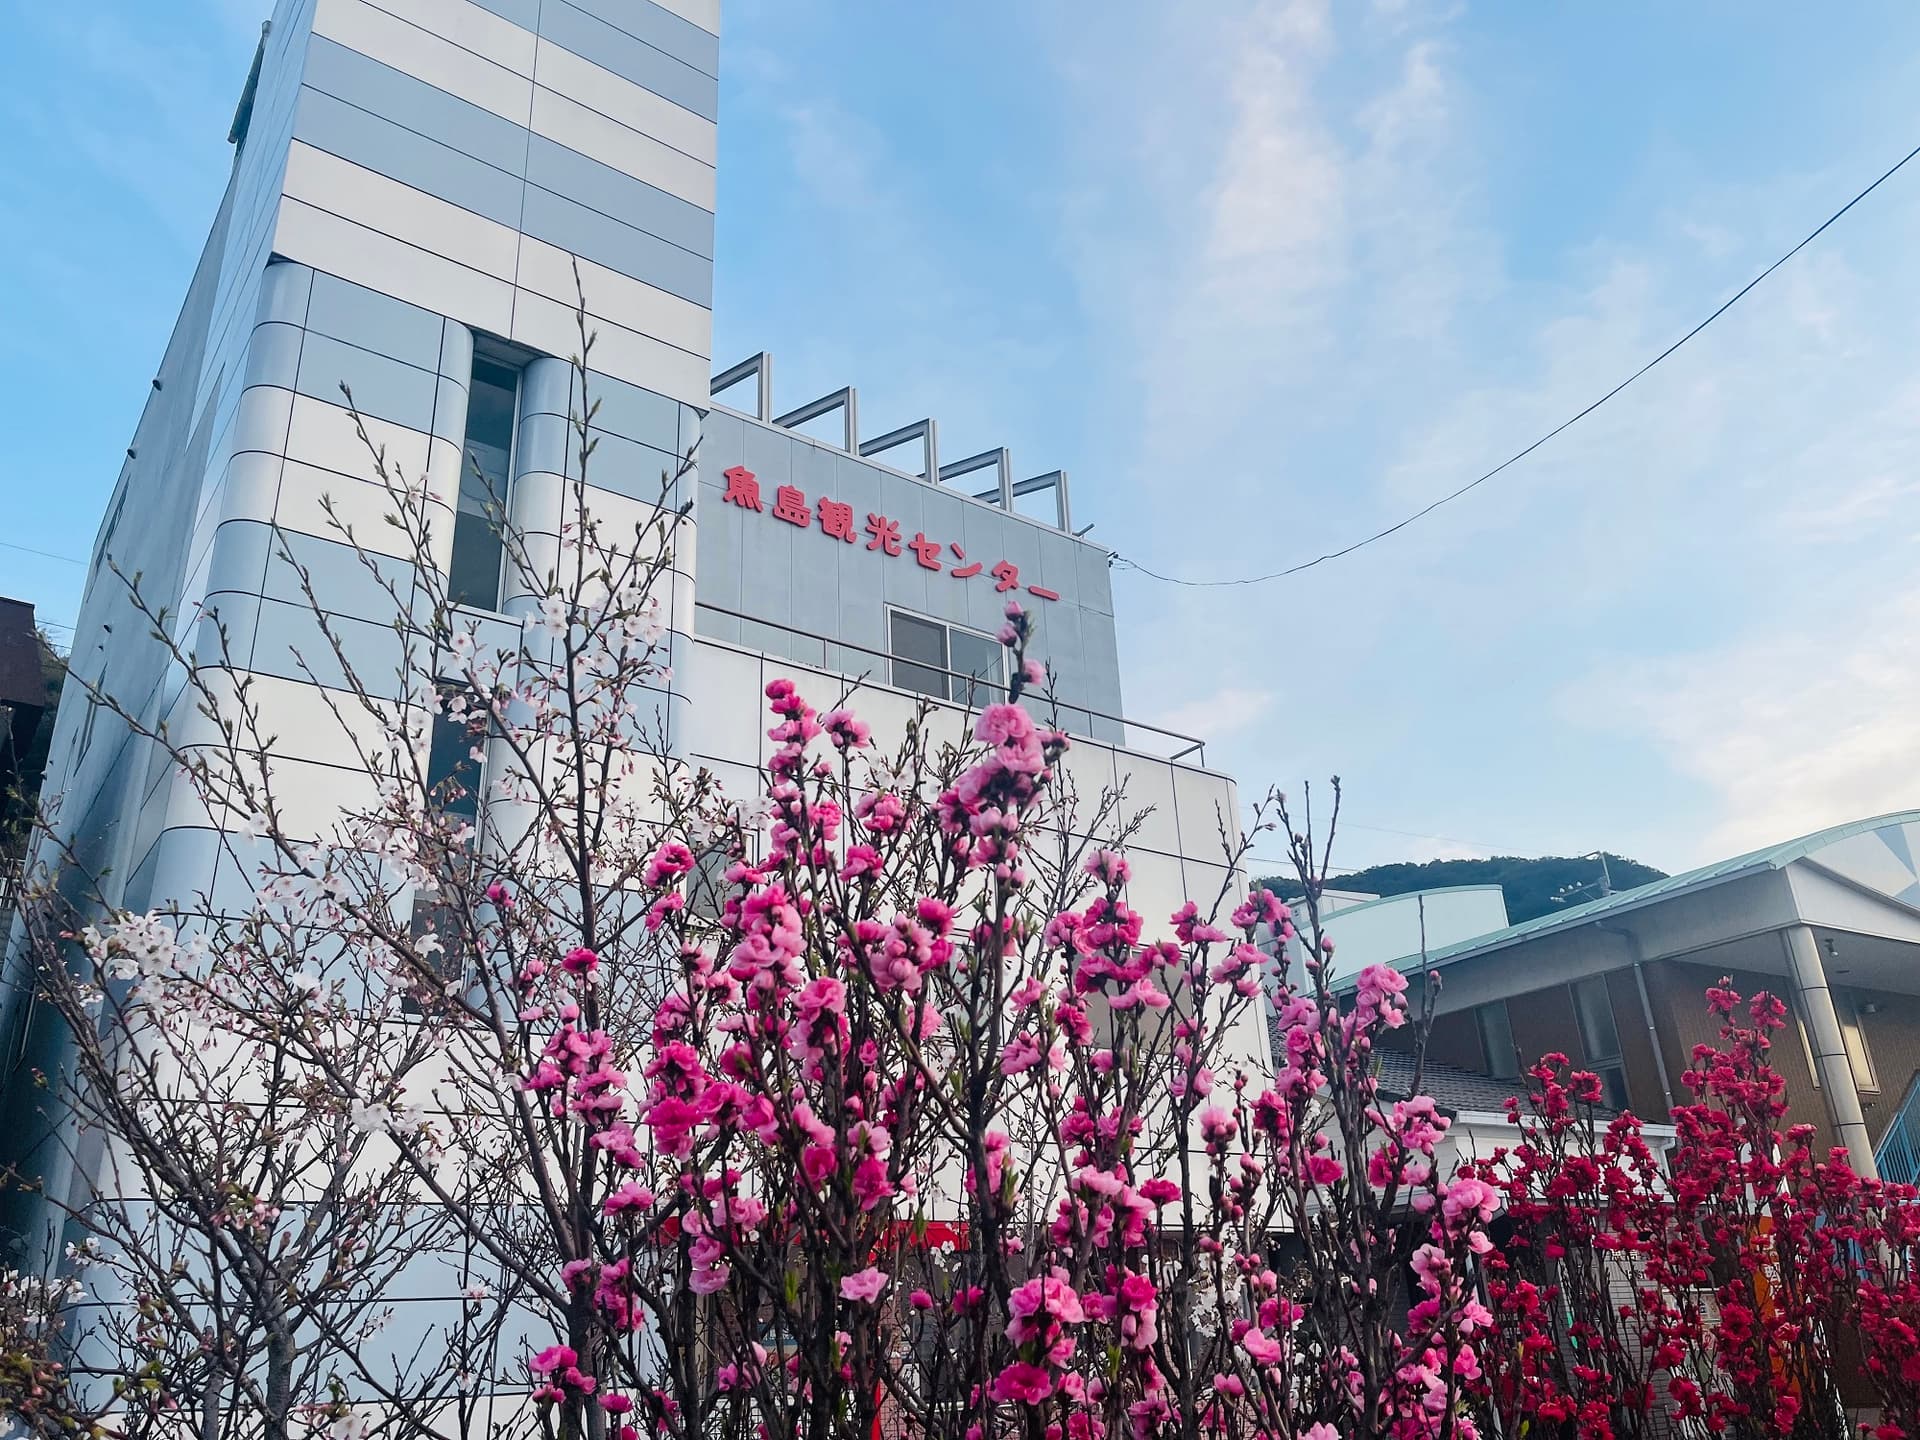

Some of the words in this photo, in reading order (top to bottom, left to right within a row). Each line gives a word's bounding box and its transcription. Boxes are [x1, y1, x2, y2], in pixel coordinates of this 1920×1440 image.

[723, 465, 1061, 601] 魚島観光センター
